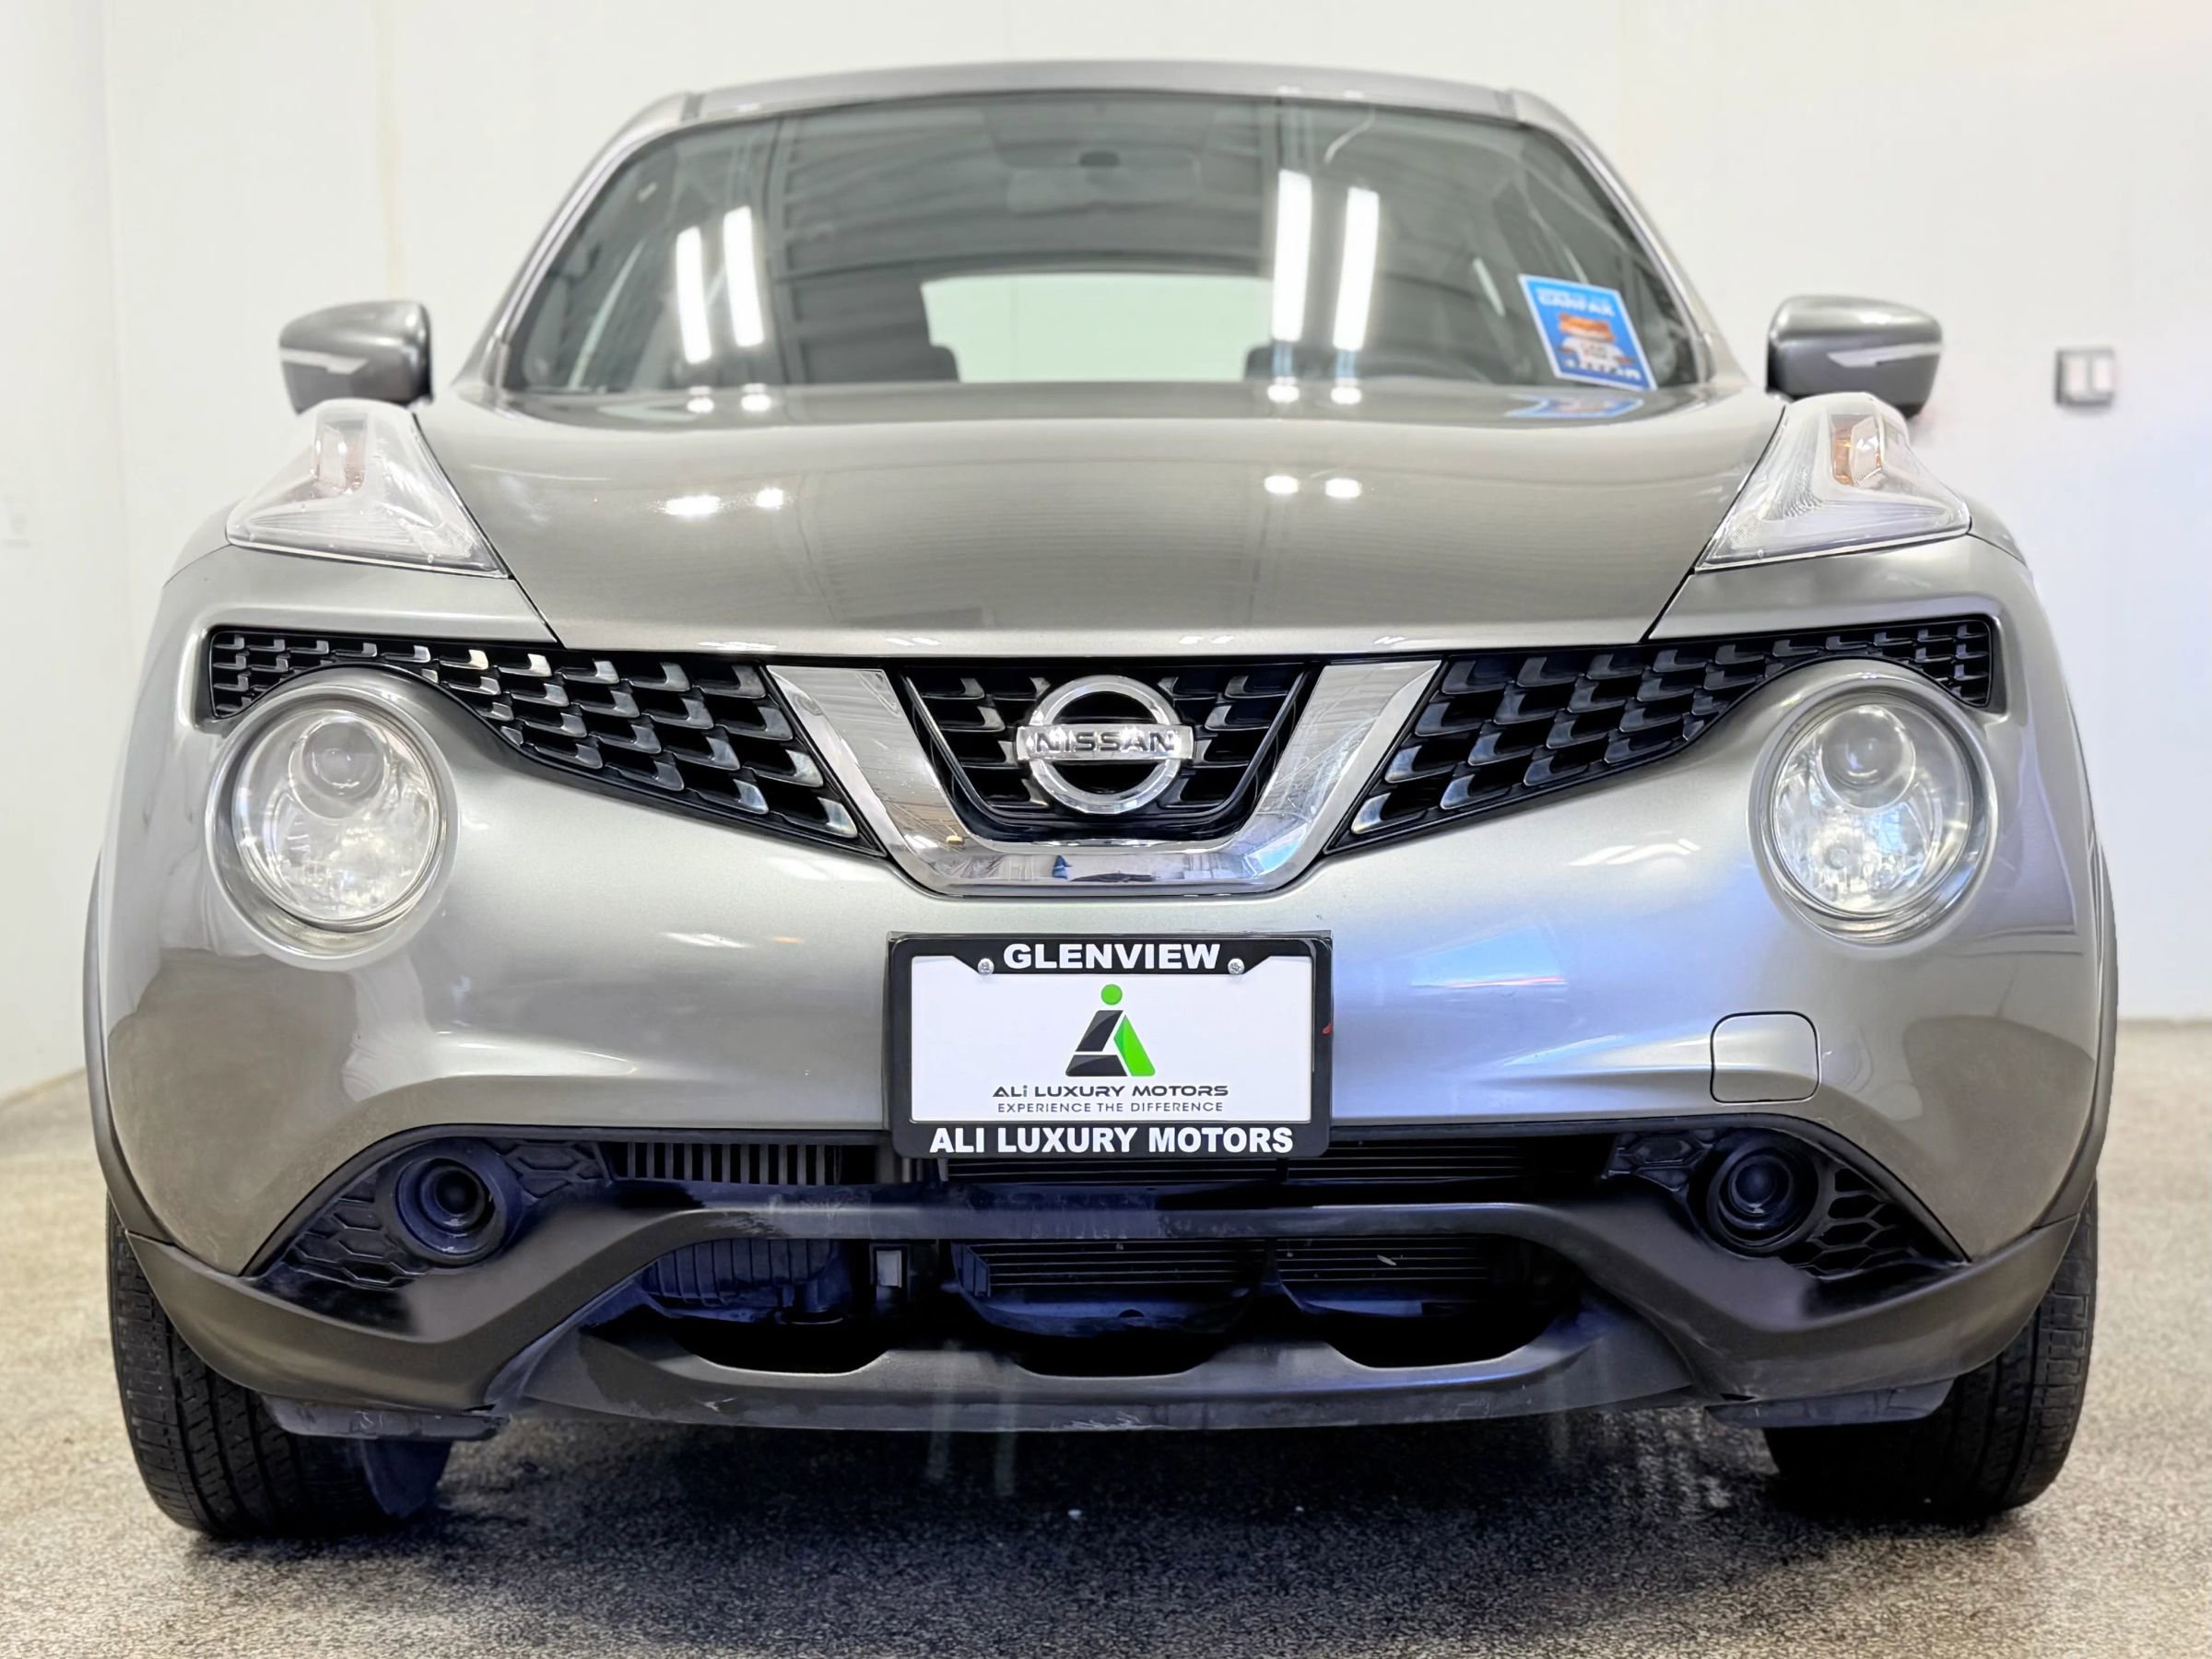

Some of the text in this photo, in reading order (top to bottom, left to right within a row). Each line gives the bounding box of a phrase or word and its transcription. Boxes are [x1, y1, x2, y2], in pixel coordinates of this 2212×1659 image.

[1034, 731, 1175, 753] NISSAN
[1003, 943, 1221, 970] GLENVIEW
[1034, 1086, 1125, 1098] LUXURY
[1132, 1085, 1229, 1097] MOTORS
[997, 1101, 1223, 1113] EXPERIENCE THE DIFFERENCE
[929, 1126, 1294, 1154] ALI LUXURY MOTORS
